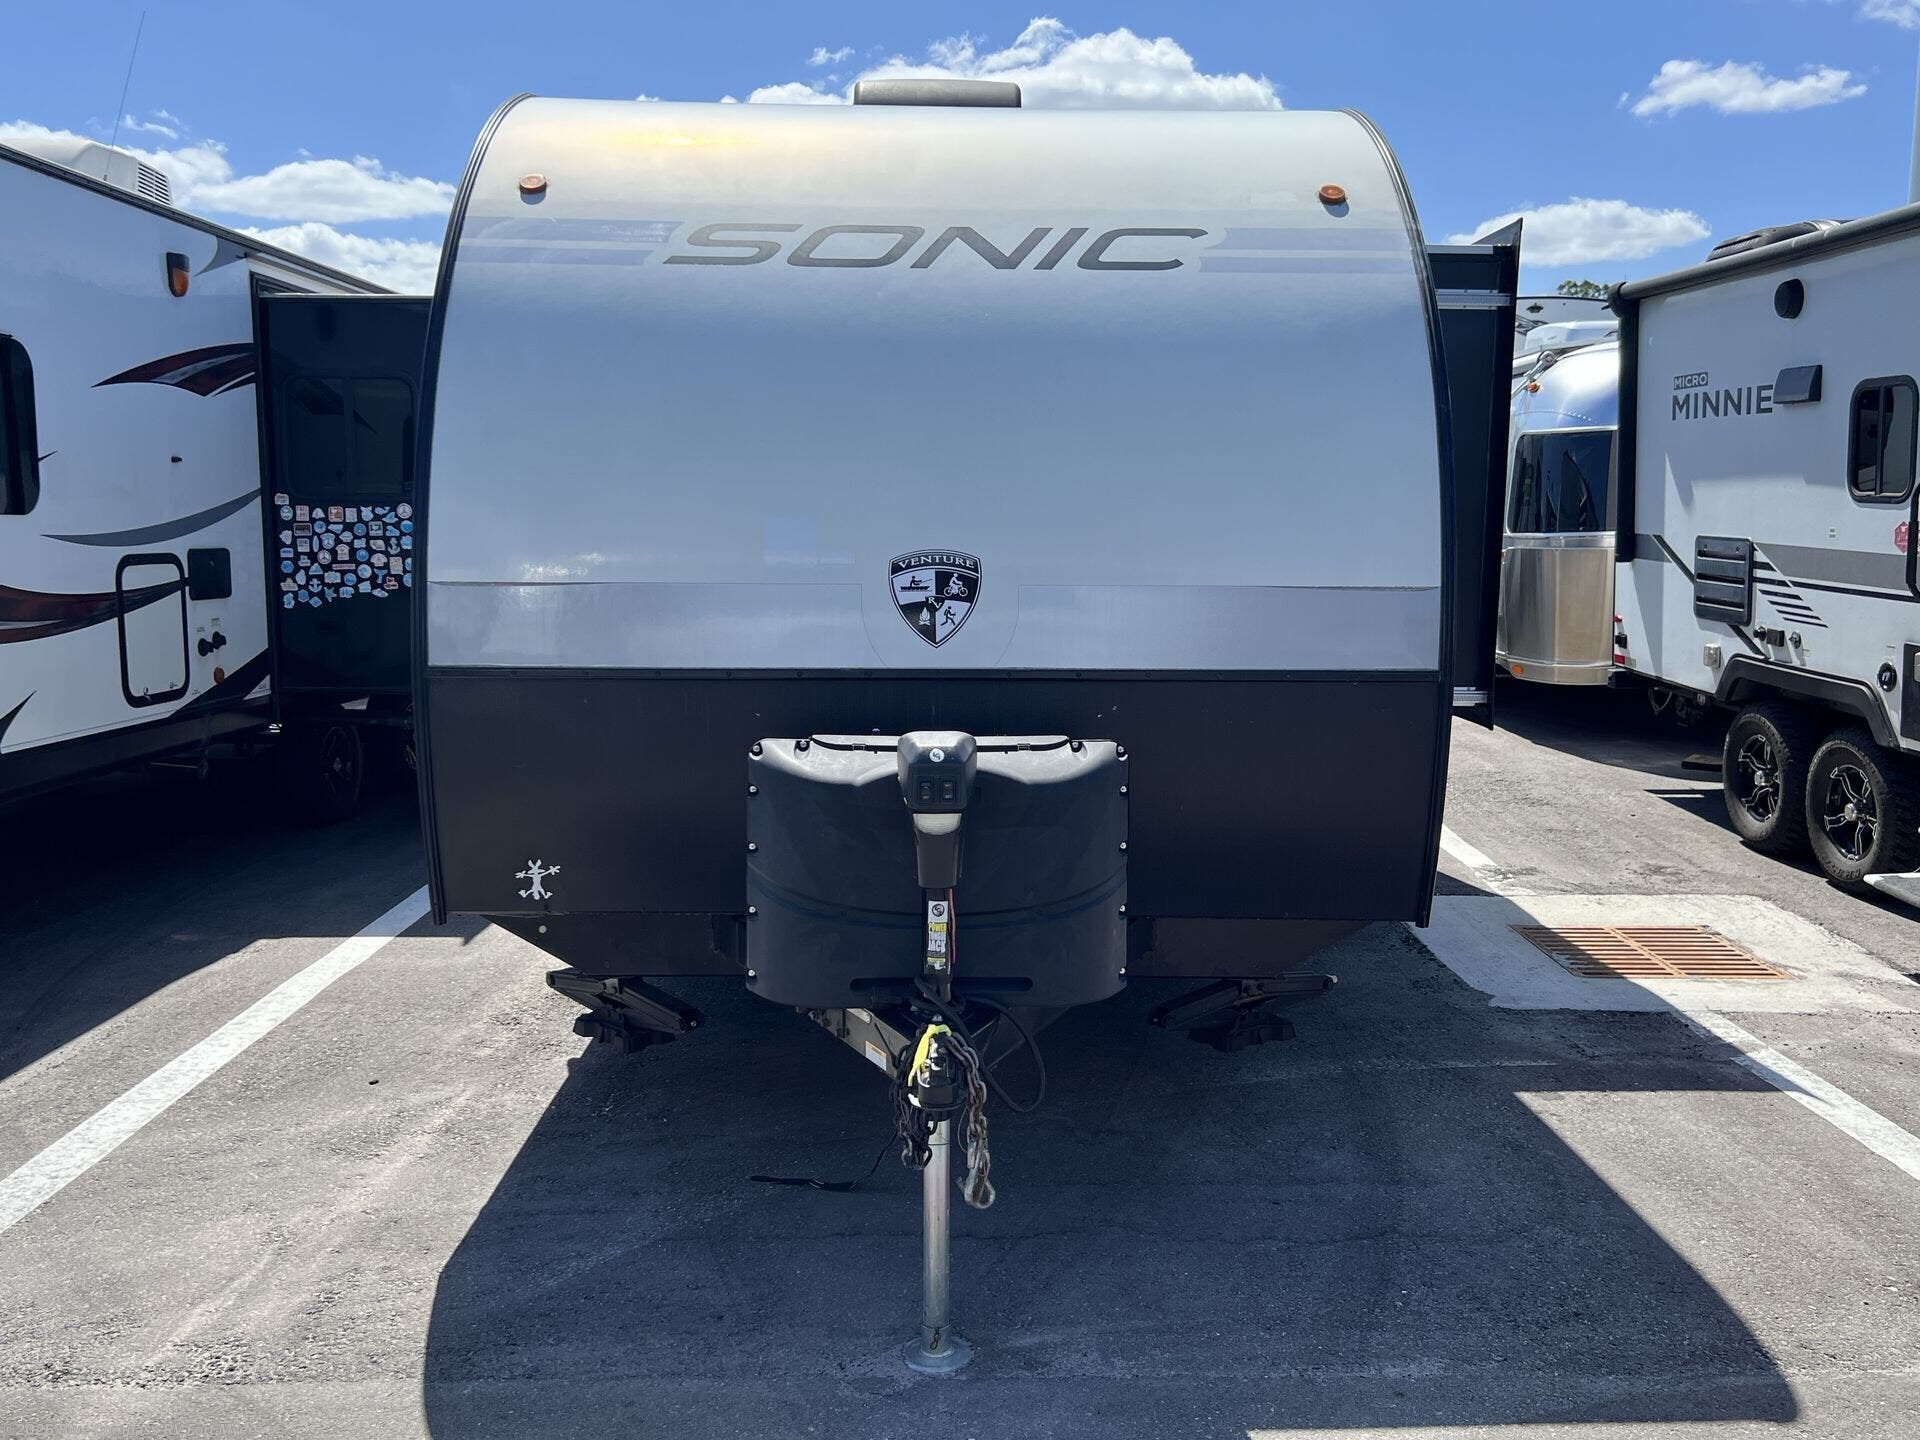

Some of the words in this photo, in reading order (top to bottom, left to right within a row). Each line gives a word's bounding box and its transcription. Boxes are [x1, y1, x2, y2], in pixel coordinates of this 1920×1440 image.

[663, 223, 1208, 271] SONIC
[1674, 373, 1707, 389] MICRO
[1672, 384, 1773, 420] MINNIE
[898, 555, 975, 568] VENTURE
[928, 597, 942, 609] RV
